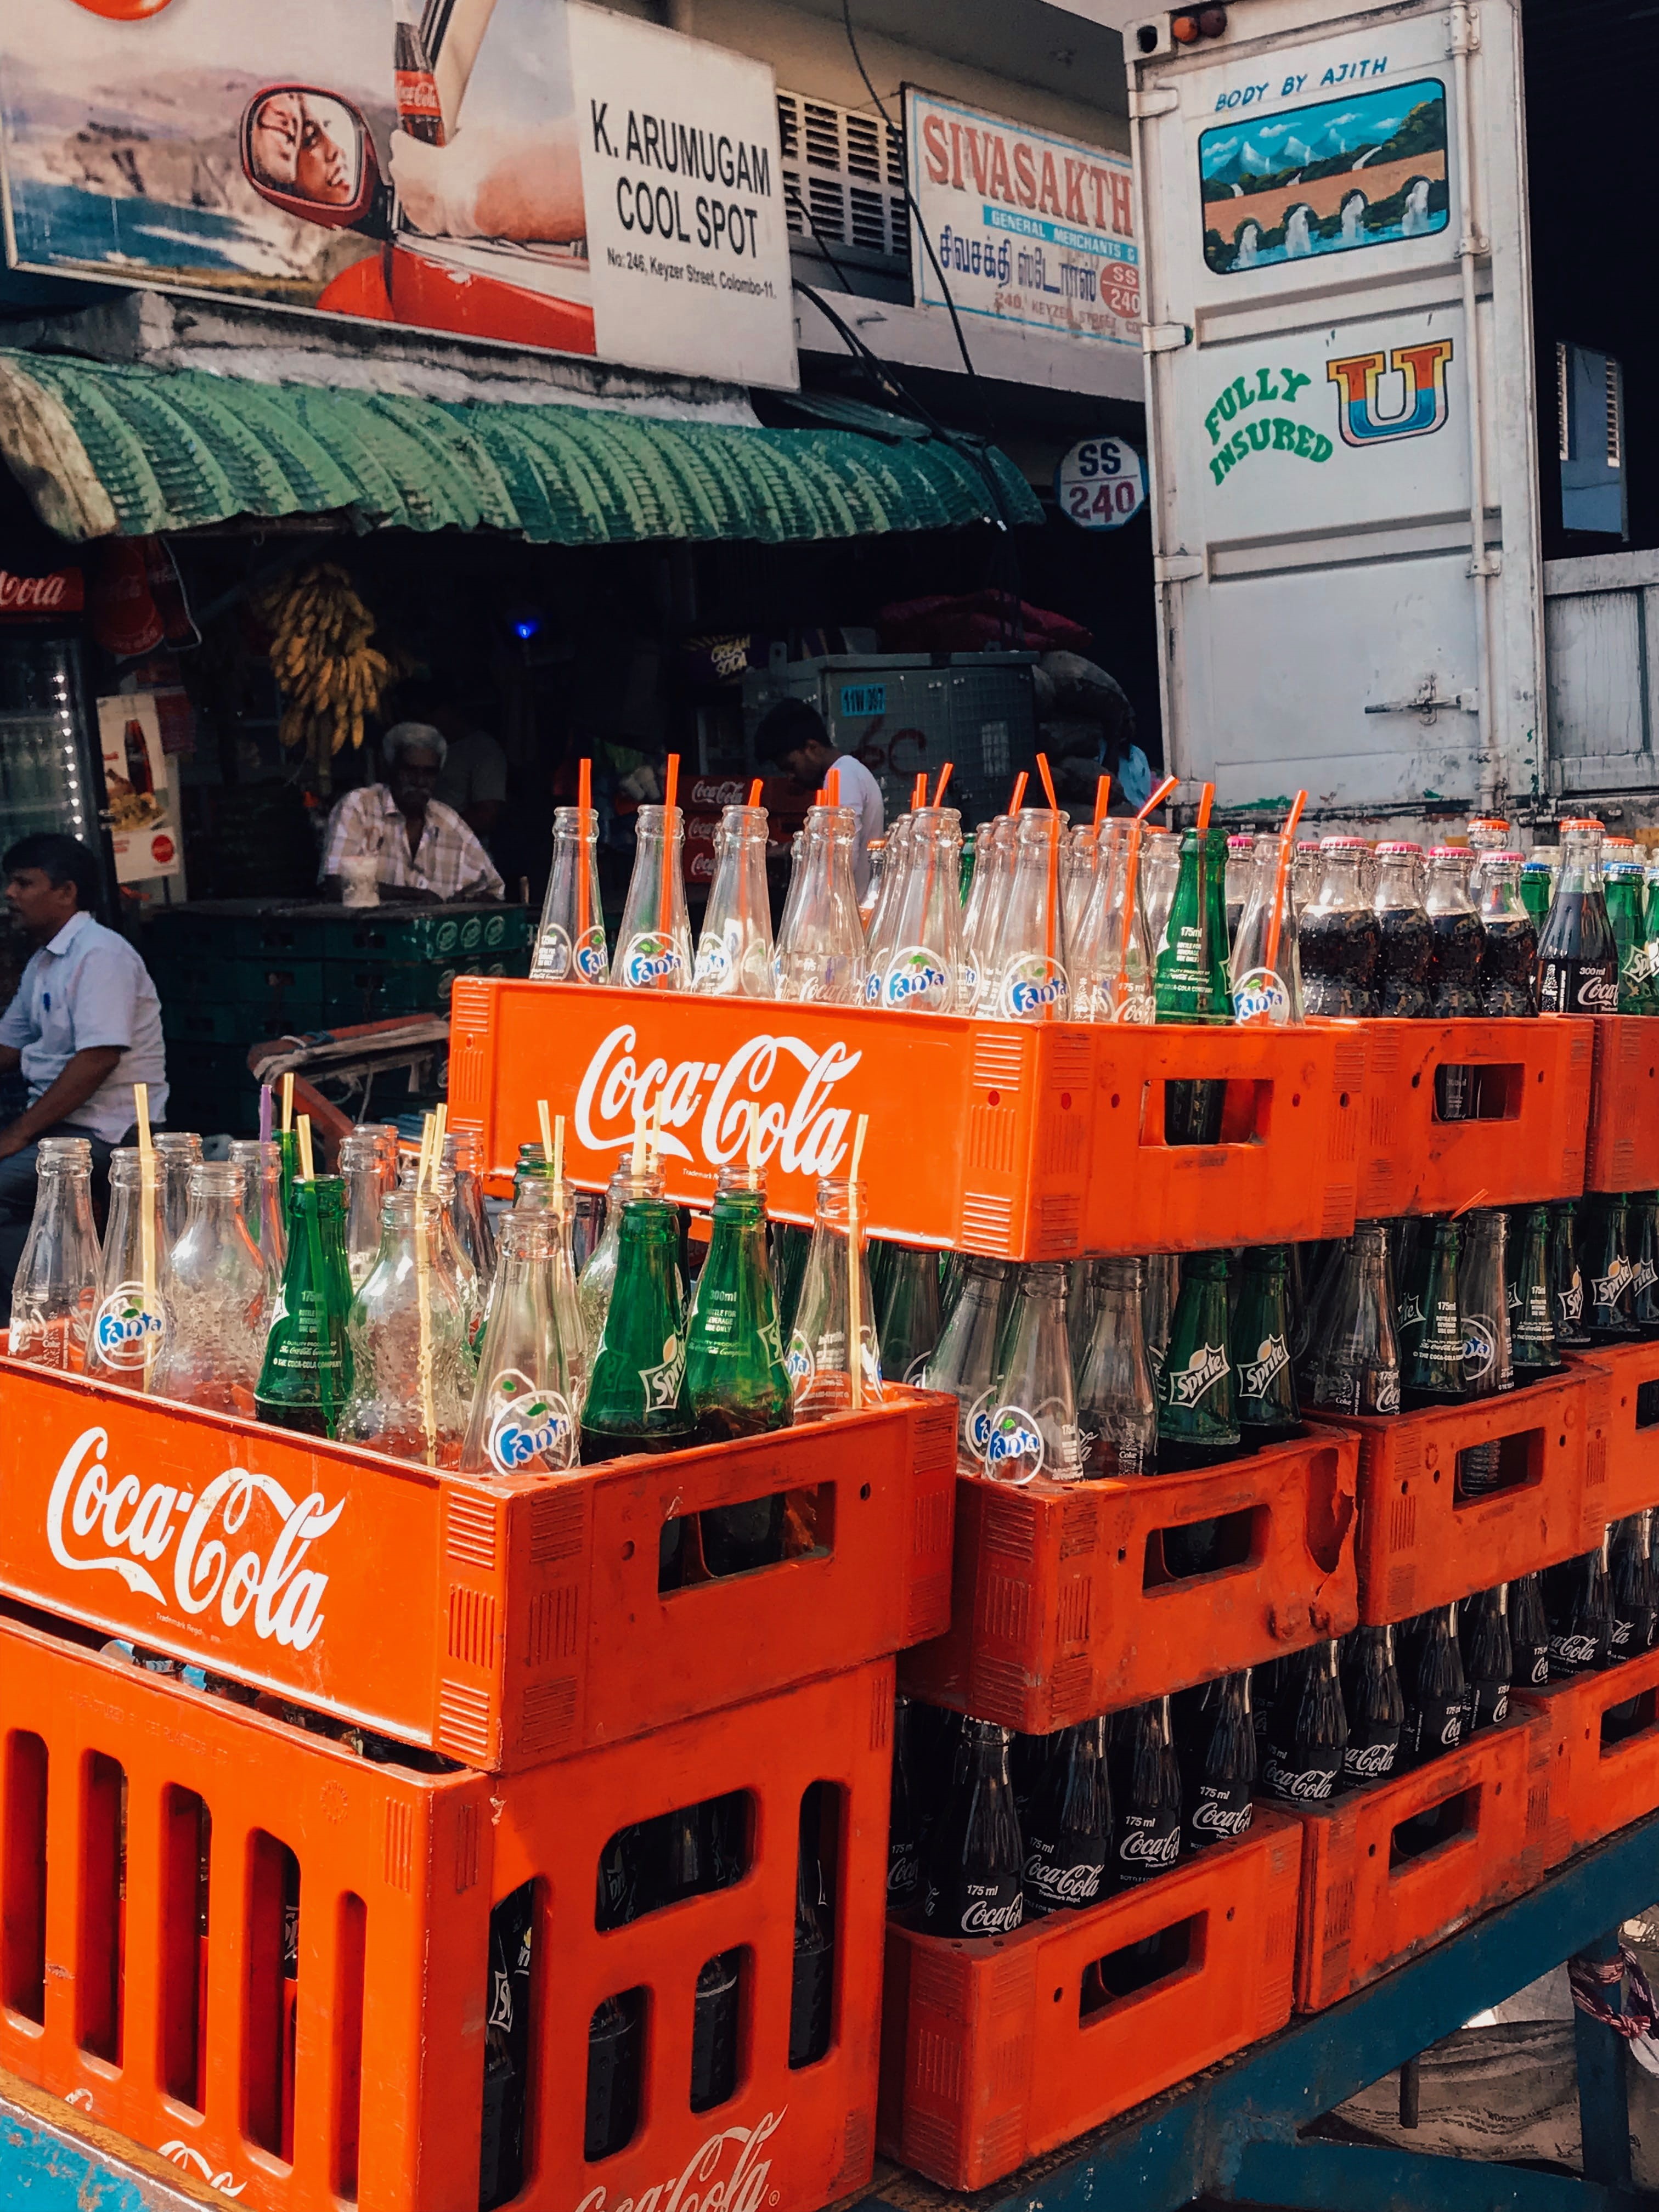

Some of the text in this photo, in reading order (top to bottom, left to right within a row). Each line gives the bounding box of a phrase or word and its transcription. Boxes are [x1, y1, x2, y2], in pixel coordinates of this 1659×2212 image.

[1216, 57, 1387, 111] BODY BY AJITH
[591, 99, 771, 196] K. ARUMUGAM
[923, 114, 1134, 238] SIVASAKTH
[617, 176, 757, 258] COOL SPOT
[991, 211, 1046, 238] GENERAL
[1053, 228, 1121, 258] MERCHANTS
[650, 255, 684, 282] Keyzer
[1113, 266, 1137, 286] SS
[1110, 288, 1142, 313] 240
[1205, 367, 1312, 446] FULLY
[1078, 442, 1121, 476] SS
[1209, 418, 1334, 486] INSURED
[1069, 481, 1135, 523] 240
[629, 950, 682, 985] Fanta
[887, 967, 945, 1005] Fanta
[1008, 976, 1068, 1017] Fanta
[1232, 989, 1283, 1024] Fanta
[575, 1024, 863, 1177] Coca-Cola
[1599, 1265, 1629, 1302] Sprite
[98, 1312, 163, 1351] Fanta
[1176, 1351, 1224, 1402] Sprite
[1246, 1343, 1286, 1393] Sprite
[495, 1413, 571, 1469] Fanta
[988, 1426, 1041, 1464] Fanta
[47, 1426, 346, 1651] Coca-Cola
[1200, 1786, 1231, 1801] 175 ml
[1263, 1759, 1338, 1799] Coca-Cola
[1125, 1815, 1156, 1827] 175 ml
[1042, 1843, 1054, 1854] ml
[967, 1884, 999, 1897] 175 ml
[1022, 1854, 1105, 1897] Coca-Cola
[574, 2103, 789, 2212] a-Cola
